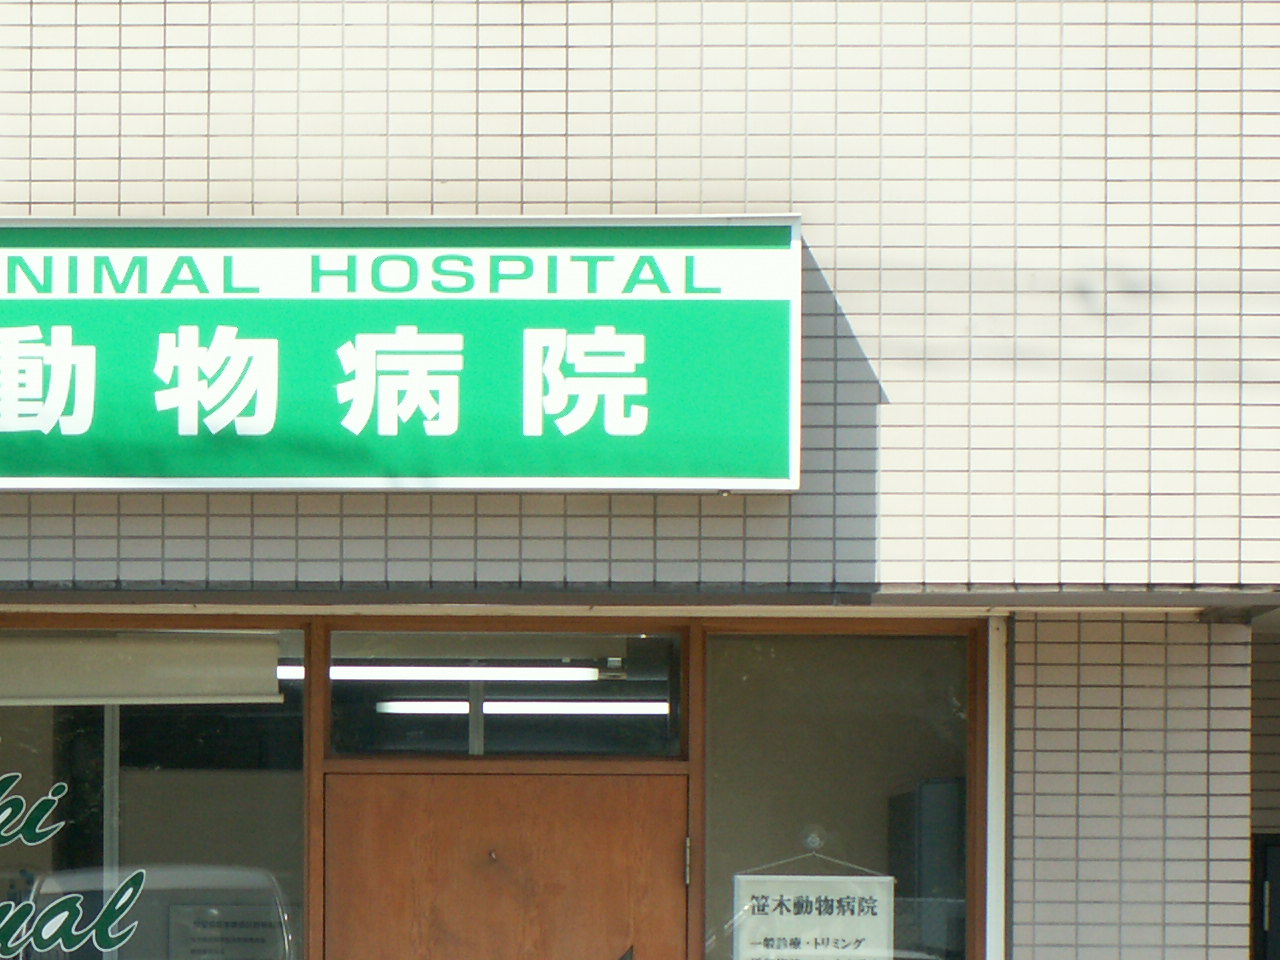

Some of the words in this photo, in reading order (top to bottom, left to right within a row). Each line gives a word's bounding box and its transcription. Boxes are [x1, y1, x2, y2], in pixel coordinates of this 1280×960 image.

[310, 255, 722, 294] HOSPITAL
[750, 895, 878, 916] 笹木動物病院
